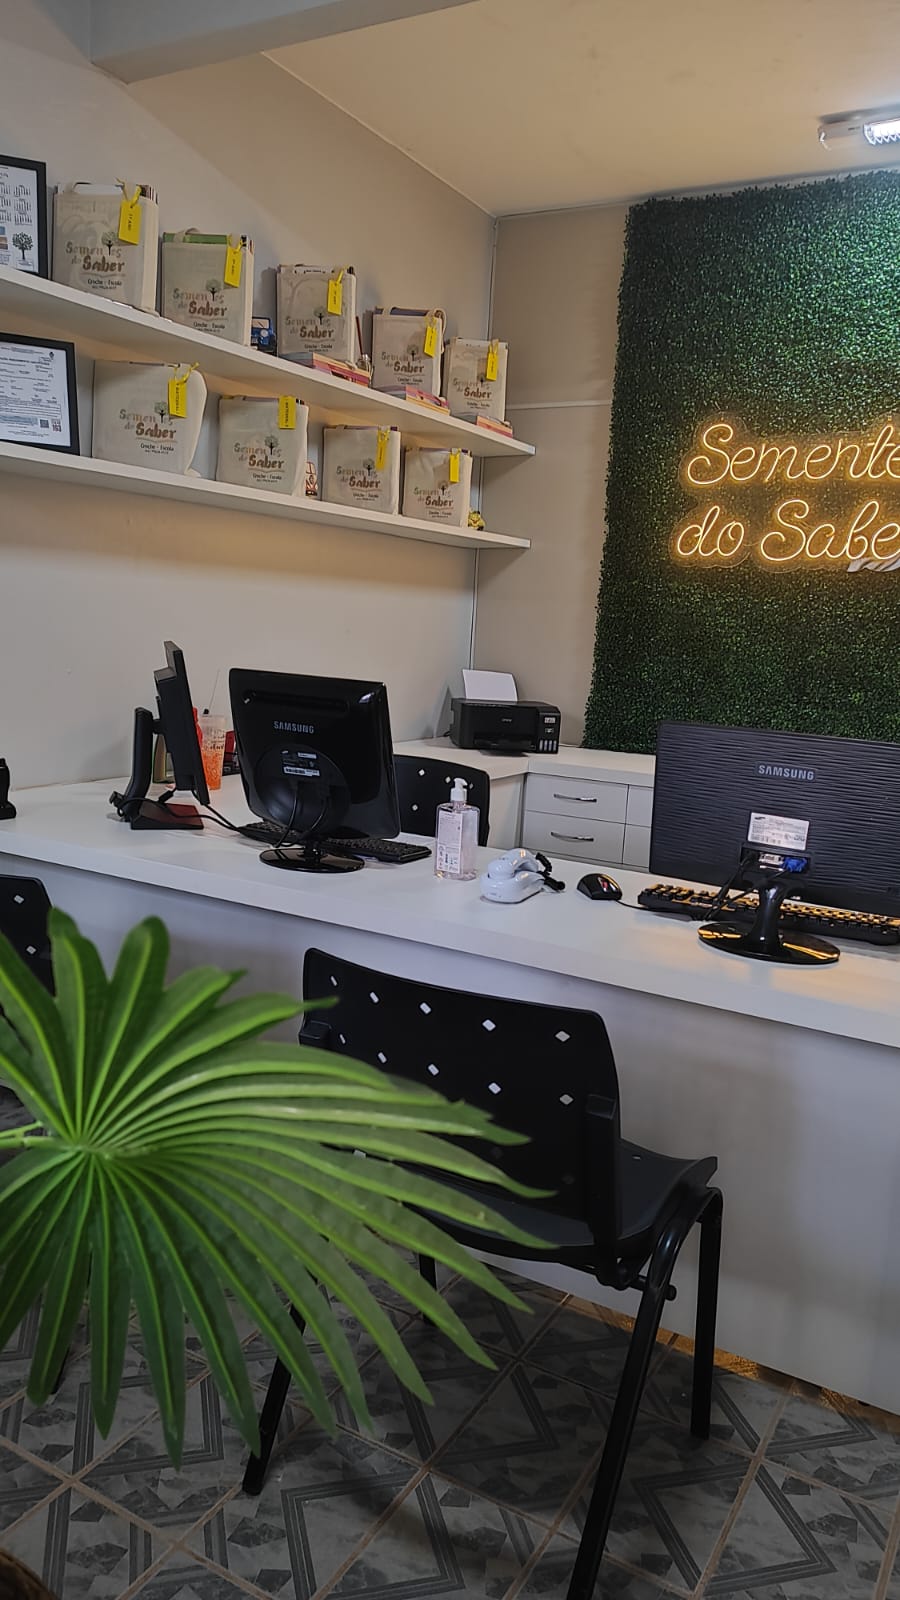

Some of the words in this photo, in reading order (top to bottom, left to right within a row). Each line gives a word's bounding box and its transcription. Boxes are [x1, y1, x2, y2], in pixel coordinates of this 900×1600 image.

[82, 255, 126, 273] Saber
[188, 301, 228, 317] Saber
[300, 325, 335, 339] Saber
[393, 360, 425, 374] Saber
[463, 386, 493, 399] Saber
[135, 422, 177, 439] Saber
[248, 454, 285, 469] Saber
[348, 475, 381, 489] Saber
[425, 495, 454, 507] Saber
[677, 505, 745, 557] do
[273, 720, 315, 734] SAMSUNG
[758, 764, 815, 780] SAMSUNG
